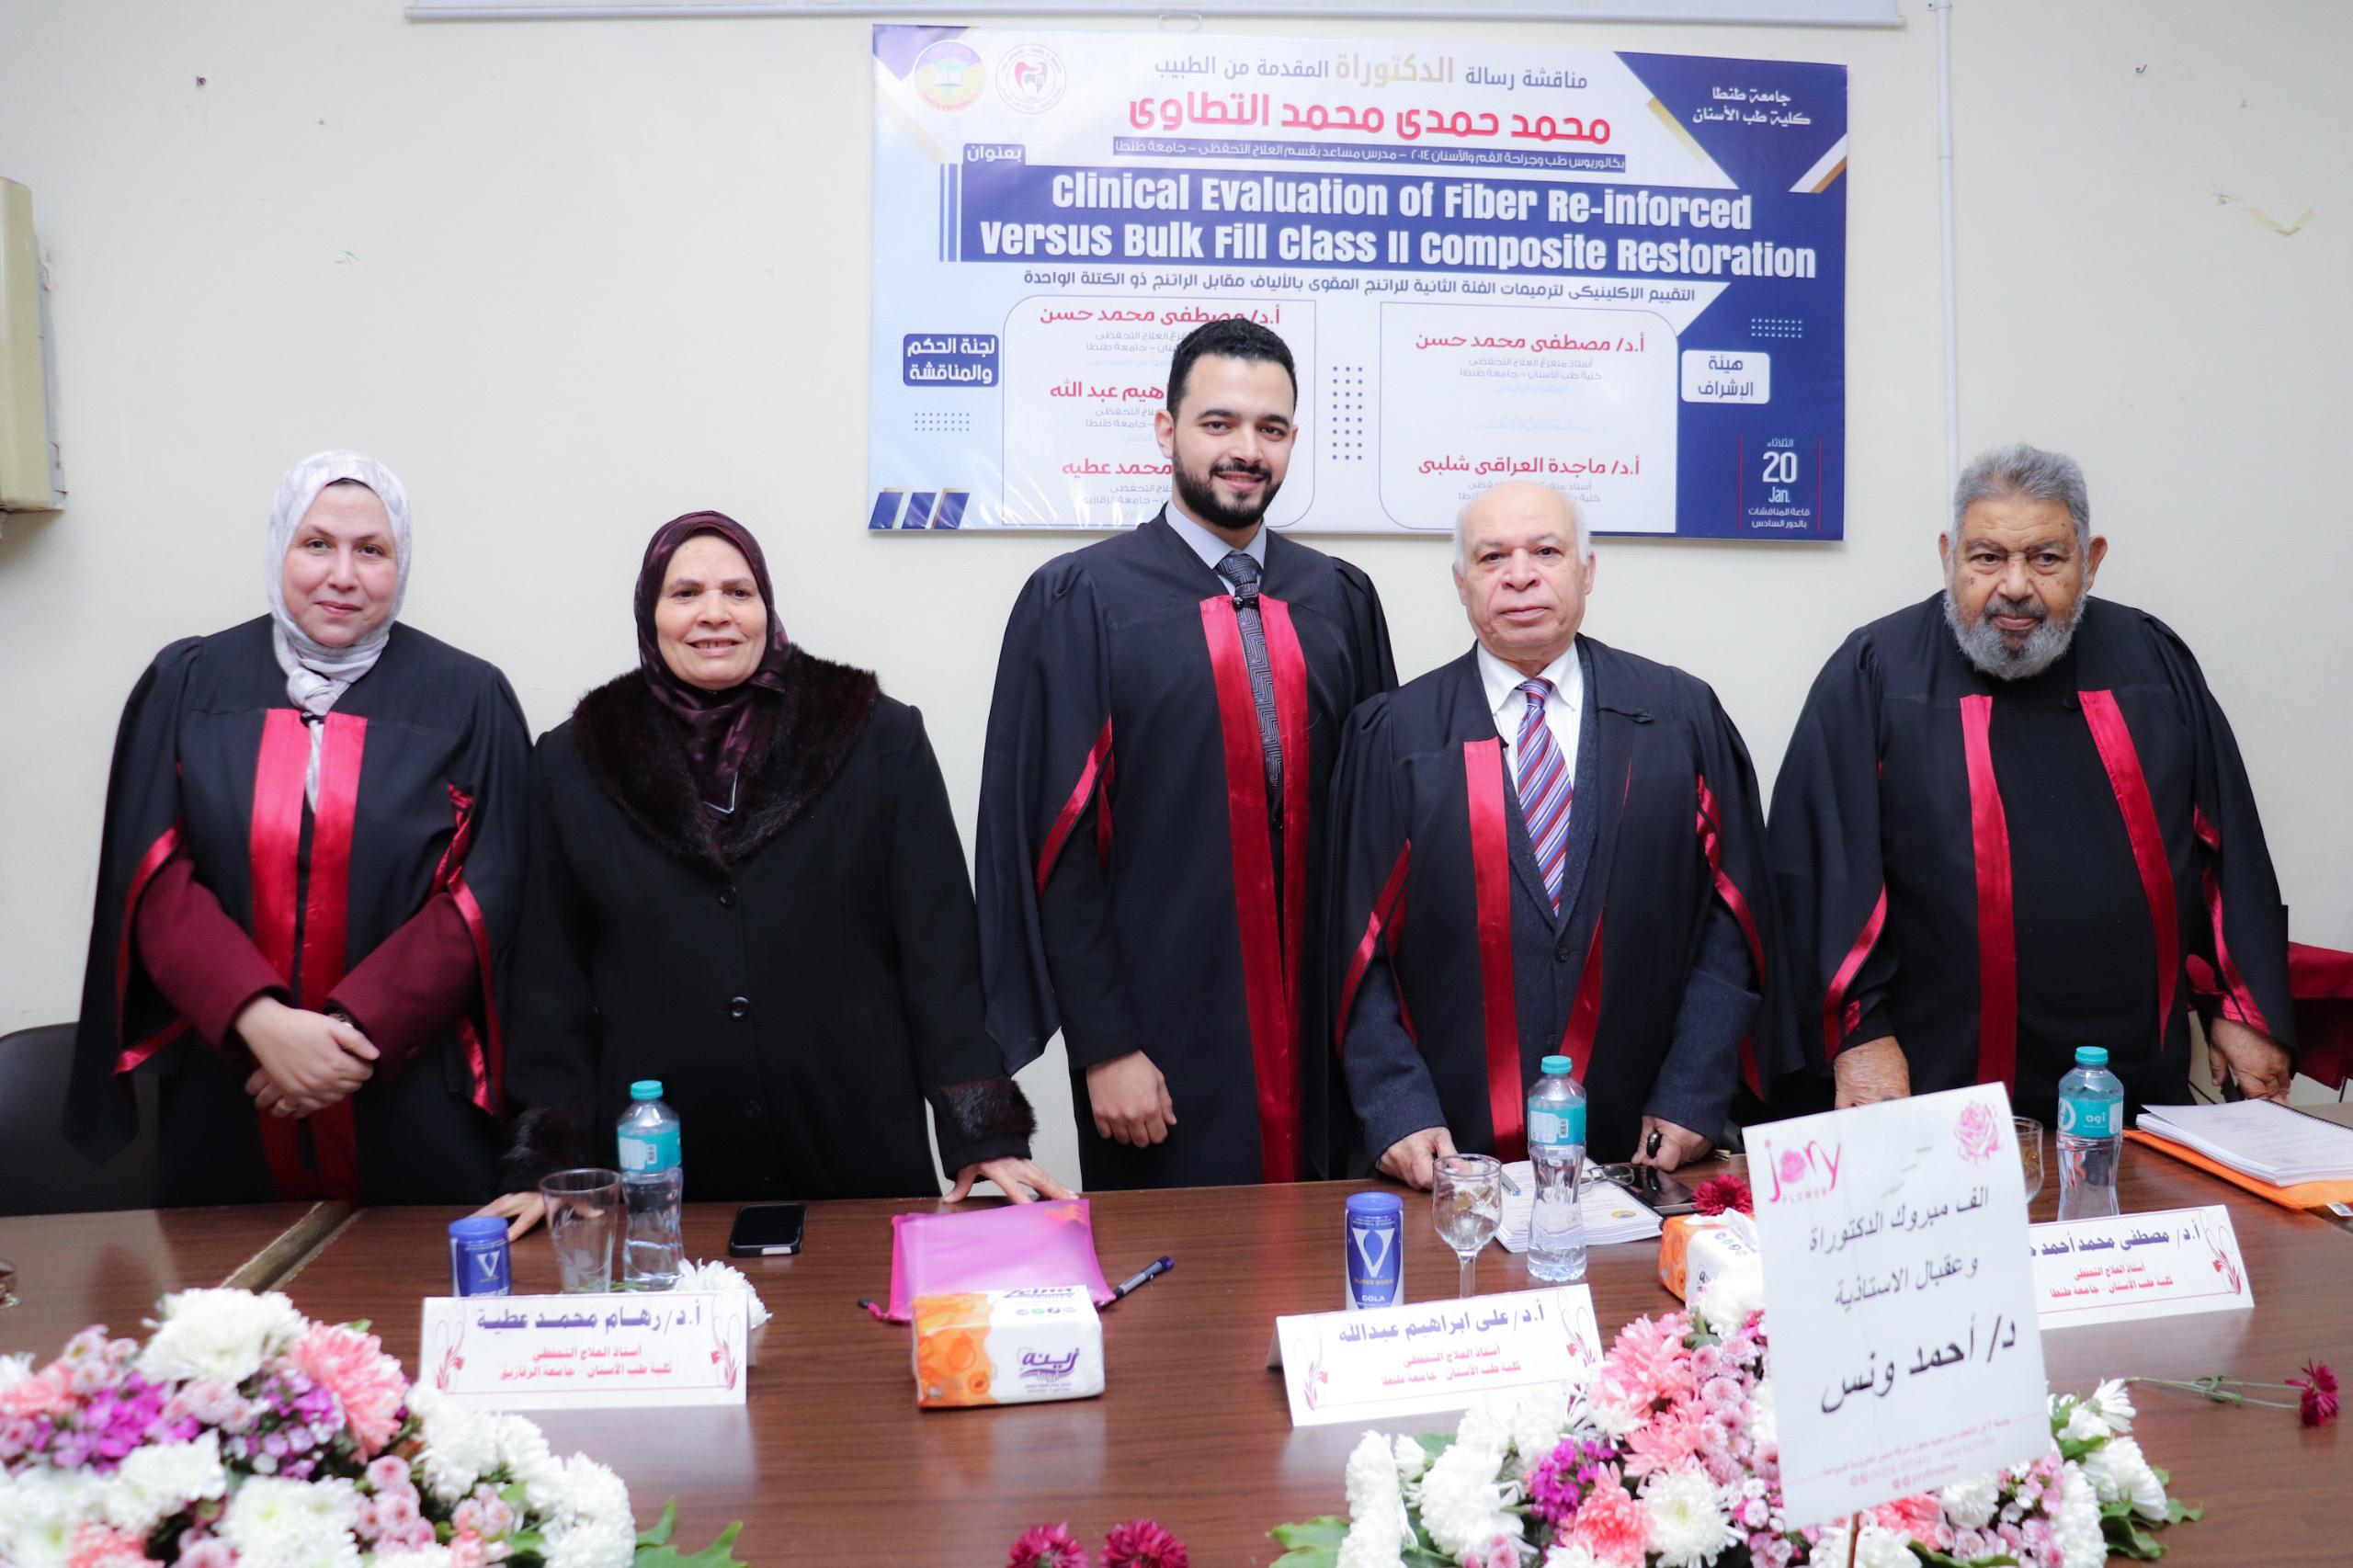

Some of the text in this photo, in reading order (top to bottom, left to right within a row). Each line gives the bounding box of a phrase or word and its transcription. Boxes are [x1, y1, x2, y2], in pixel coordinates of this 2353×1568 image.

[1154, 55, 1216, 79] الطبيب
[1224, 60, 1249, 81] من
[1256, 59, 1329, 79] المقدمة
[1465, 66, 1516, 92] رسالة
[1522, 68, 1588, 91] مناقشة
[1711, 85, 1792, 108] جامعة طنطا
[1281, 103, 1384, 134] محمد
[1396, 109, 1499, 141] حمدى
[1742, 109, 1768, 126] طب
[1768, 109, 1813, 128] كلية
[1510, 114, 1611, 145] محمد
[967, 146, 1022, 164] بعنوان
[1052, 172, 1752, 231] Clinical Evaluation of Fiber Re-inforced
[980, 221, 1816, 279] Versus Bulk Fill Class II Composite Restoration
[1023, 269, 1075, 287] الواحدة
[1080, 270, 1125, 285] الكتلة
[1130, 271, 1147, 289] ذو
[1154, 272, 1198, 292] الراتنج
[1202, 273, 1245, 291] مقابل
[1363, 278, 1408, 297] للراتنج
[1414, 279, 1456, 296] الثانية
[1500, 283, 1563, 300] لترميمات
[1648, 287, 1695, 304] التقييم
[1040, 307, 1095, 324] حسن
[1097, 308, 1155, 323] محمد
[907, 336, 995, 358] لجنة الحكم
[1415, 333, 1467, 350] حسن
[1470, 336, 1526, 349] محمد
[1529, 333, 1611, 353] مصطفى
[909, 361, 993, 384] والمناقشة
[1086, 384, 1119, 403] عبد
[1698, 379, 1755, 402] الإشراف
[1115, 461, 1173, 475] محمد
[1547, 457, 1606, 478] ماجدة
[1762, 451, 1797, 483] 20
[1768, 486, 1791, 503] Jan.
[1890, 1202, 1949, 1233] مبروك
[2040, 1231, 2075, 1256] أحمد
[2078, 1235, 2115, 1252] محمد
[2120, 1229, 2170, 1250] مصطفى
[476, 1307, 529, 1335] عطية
[534, 1311, 599, 1329] محمد
[1821, 1351, 1896, 1414] ونس
